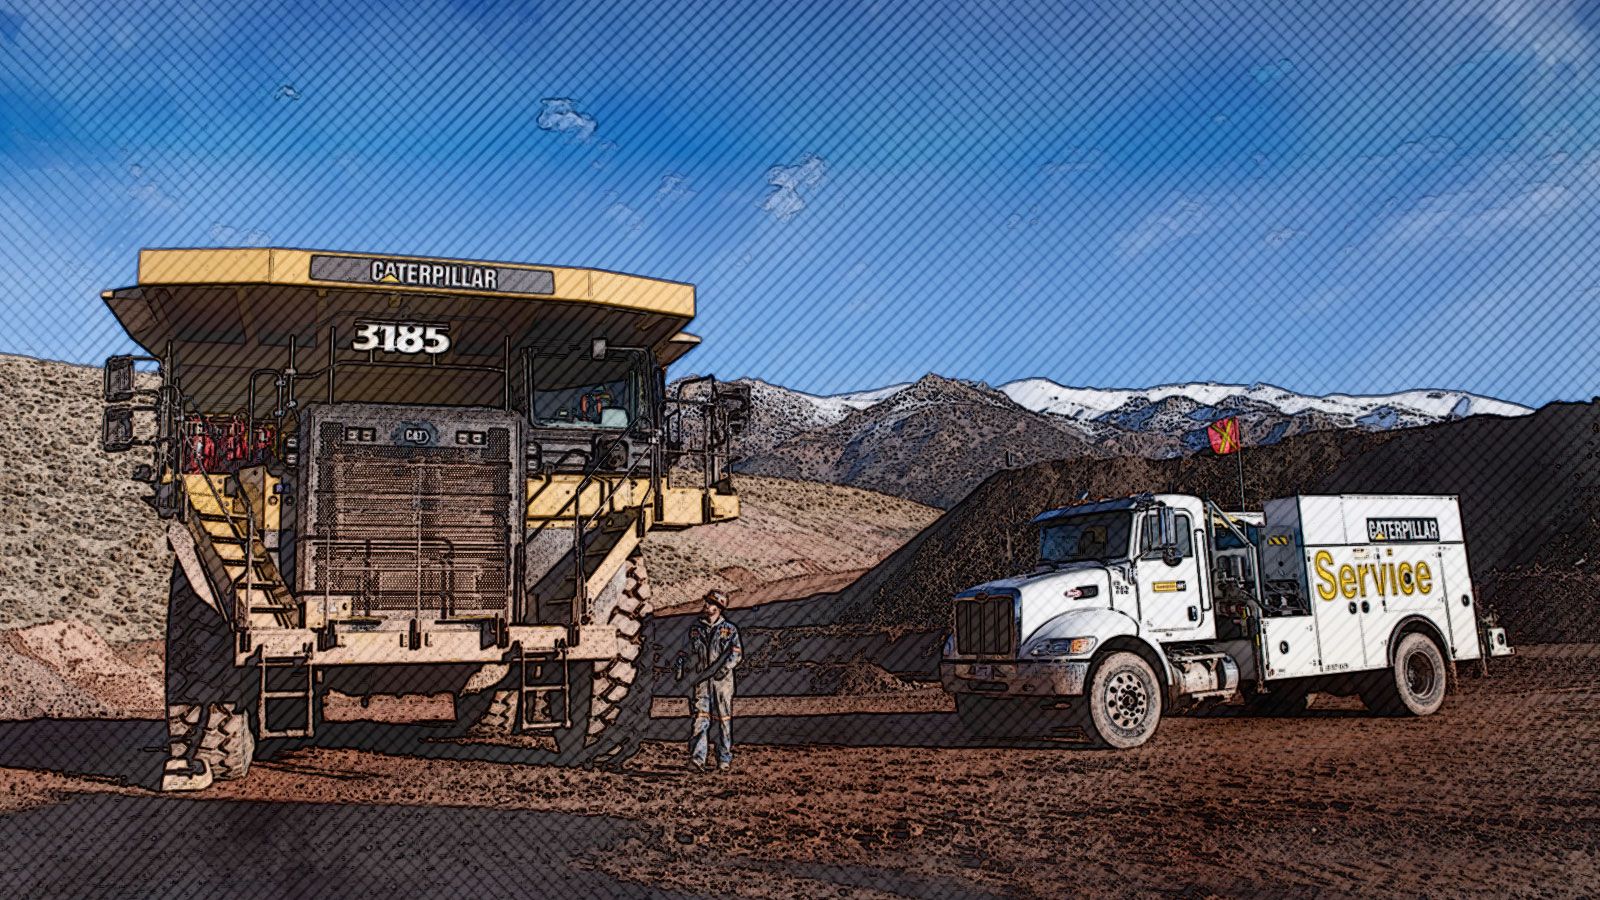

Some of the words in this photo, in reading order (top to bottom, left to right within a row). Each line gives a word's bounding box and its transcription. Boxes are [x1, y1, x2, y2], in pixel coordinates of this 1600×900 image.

[371, 260, 498, 289] CATERPILLAR
[352, 323, 451, 354] 3185
[1368, 520, 1439, 540] CATERPILLAR
[1314, 549, 1432, 601] Service
